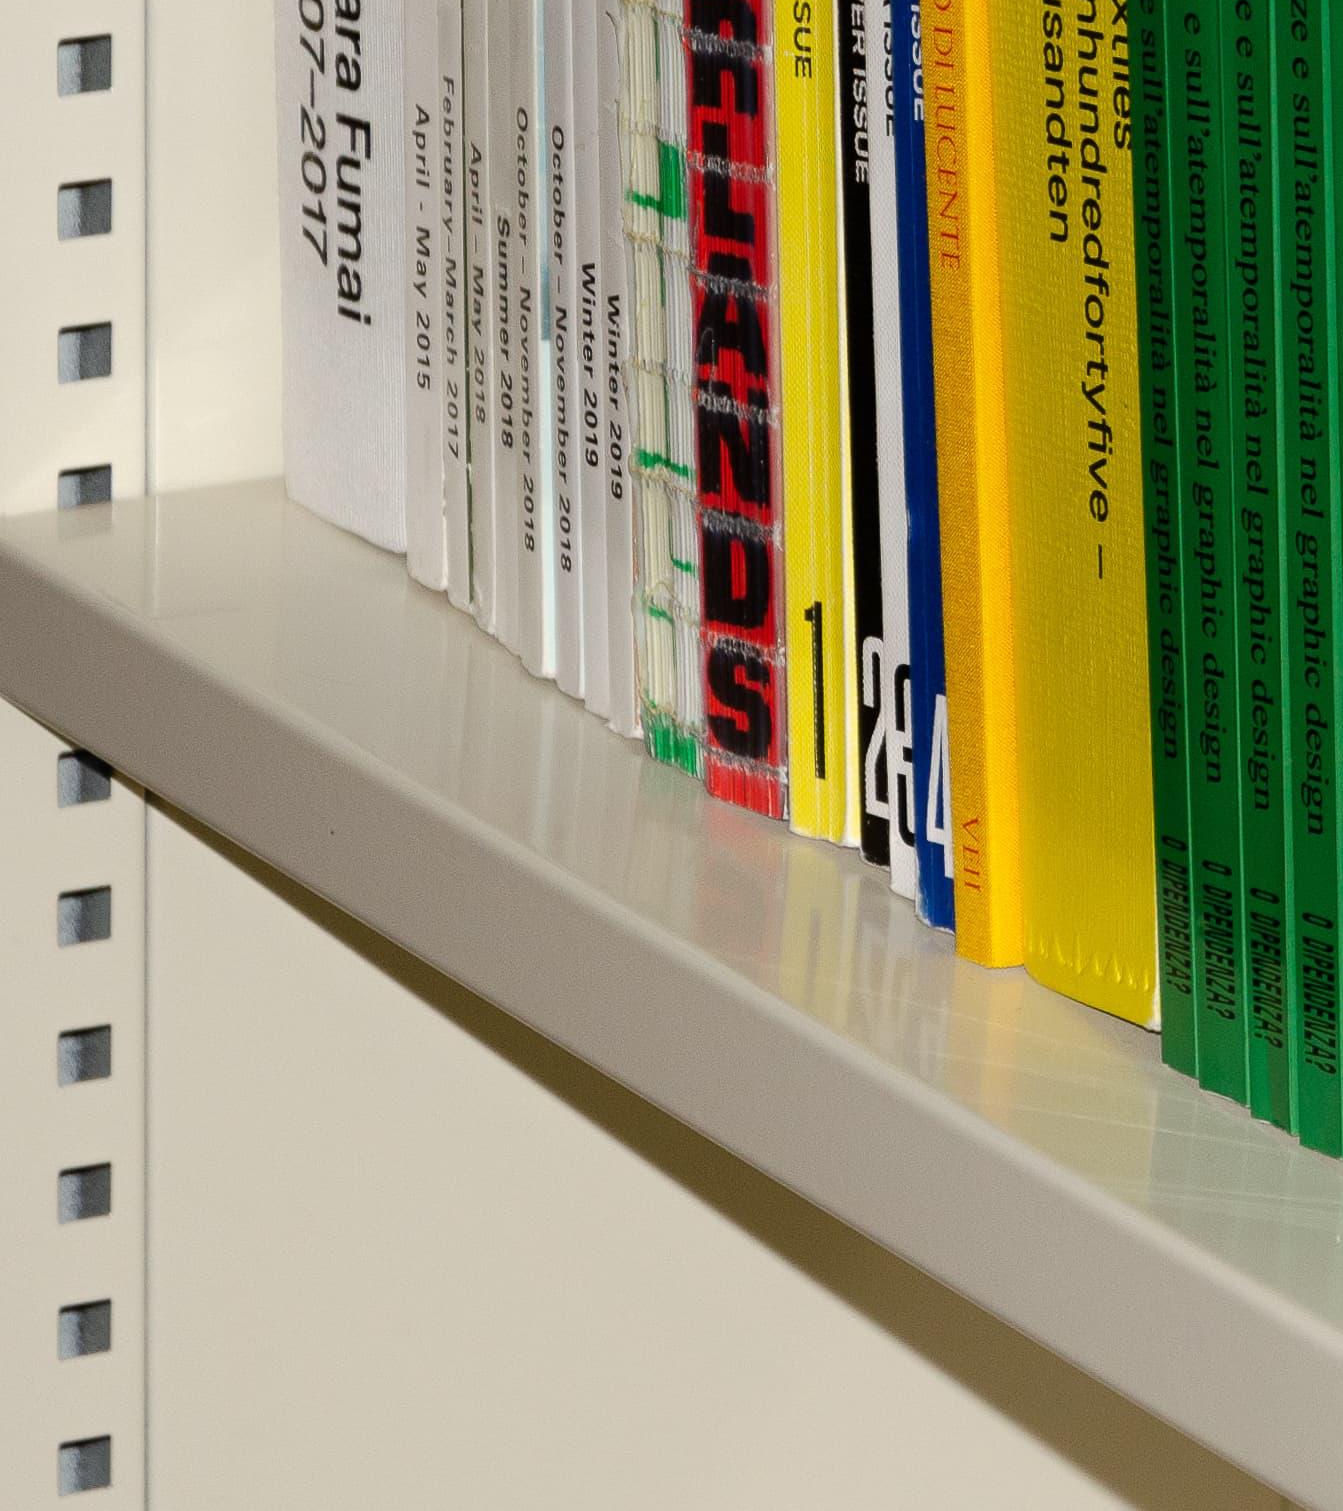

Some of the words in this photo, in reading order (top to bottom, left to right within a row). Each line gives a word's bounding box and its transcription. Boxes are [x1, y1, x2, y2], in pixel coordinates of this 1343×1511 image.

[931, 26, 954, 70] DI
[416, 103, 431, 201] April
[852, 70, 870, 184] ISSUE
[335, 111, 371, 326] Fumai
[469, 141, 482, 225] April
[515, 106, 530, 247] October
[551, 125, 566, 266] October
[934, 85, 961, 272] LUCENTE
[414, 225, 431, 298] May
[471, 264, 485, 337] May
[497, 215, 511, 359] Summer
[416, 315, 431, 390] 2015
[580, 261, 595, 374] Winter
[607, 293, 621, 406] Winter
[473, 349, 486, 424] 2018
[499, 374, 513, 448] 2018
[518, 286, 532, 465] November
[554, 305, 568, 483] November
[446, 383, 460, 460] 2017
[582, 388, 599, 467] 2019
[609, 420, 623, 500] 2019
[522, 477, 535, 553] 2018
[559, 496, 572, 573] 2018
